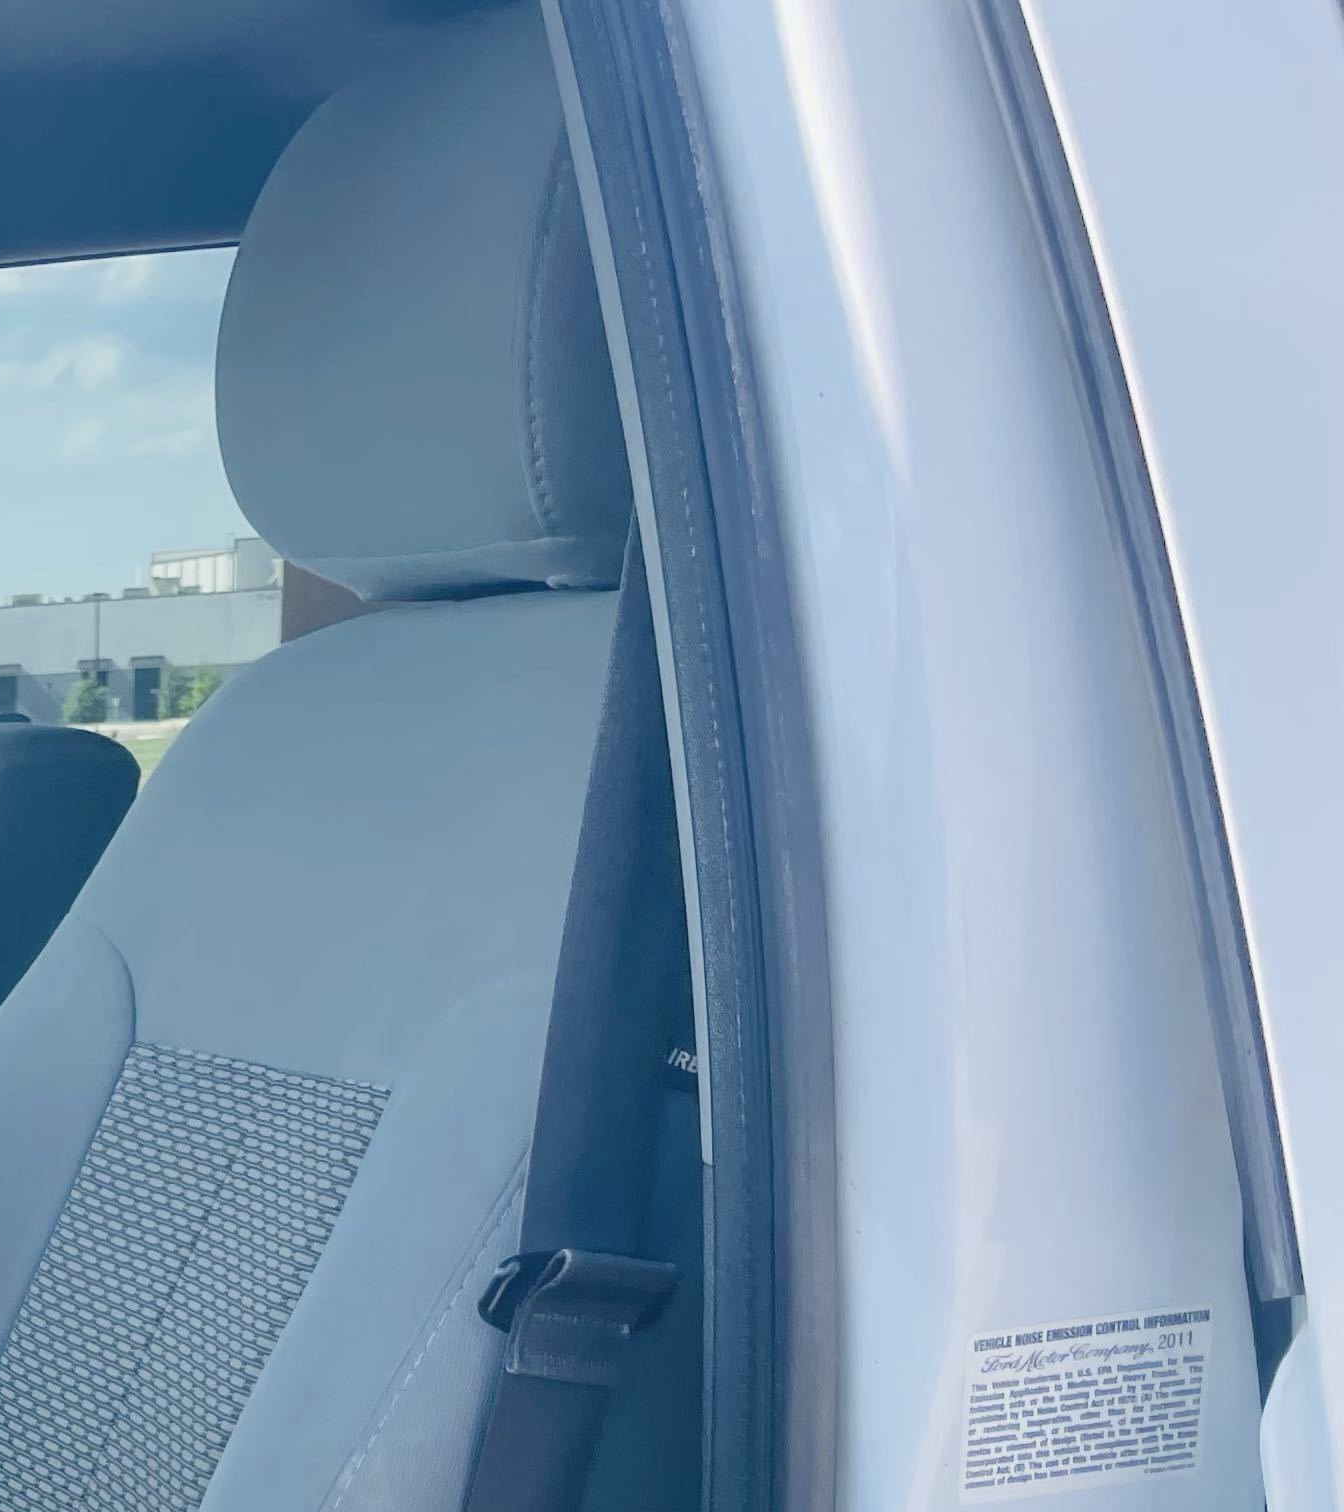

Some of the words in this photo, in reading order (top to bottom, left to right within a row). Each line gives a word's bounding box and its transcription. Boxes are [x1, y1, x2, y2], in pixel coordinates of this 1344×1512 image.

[974, 1335, 1012, 1352] VEHICLE
[1015, 1331, 1043, 1346] NOISE
[1047, 1324, 1093, 1342] EMISSION
[1096, 1318, 1140, 1335] CONTROL
[1144, 1309, 1210, 1329] INFORMATION
[981, 1353, 1022, 1373] Ford
[1016, 1348, 1070, 1372] Motor
[1158, 1331, 1193, 1350] 2011
